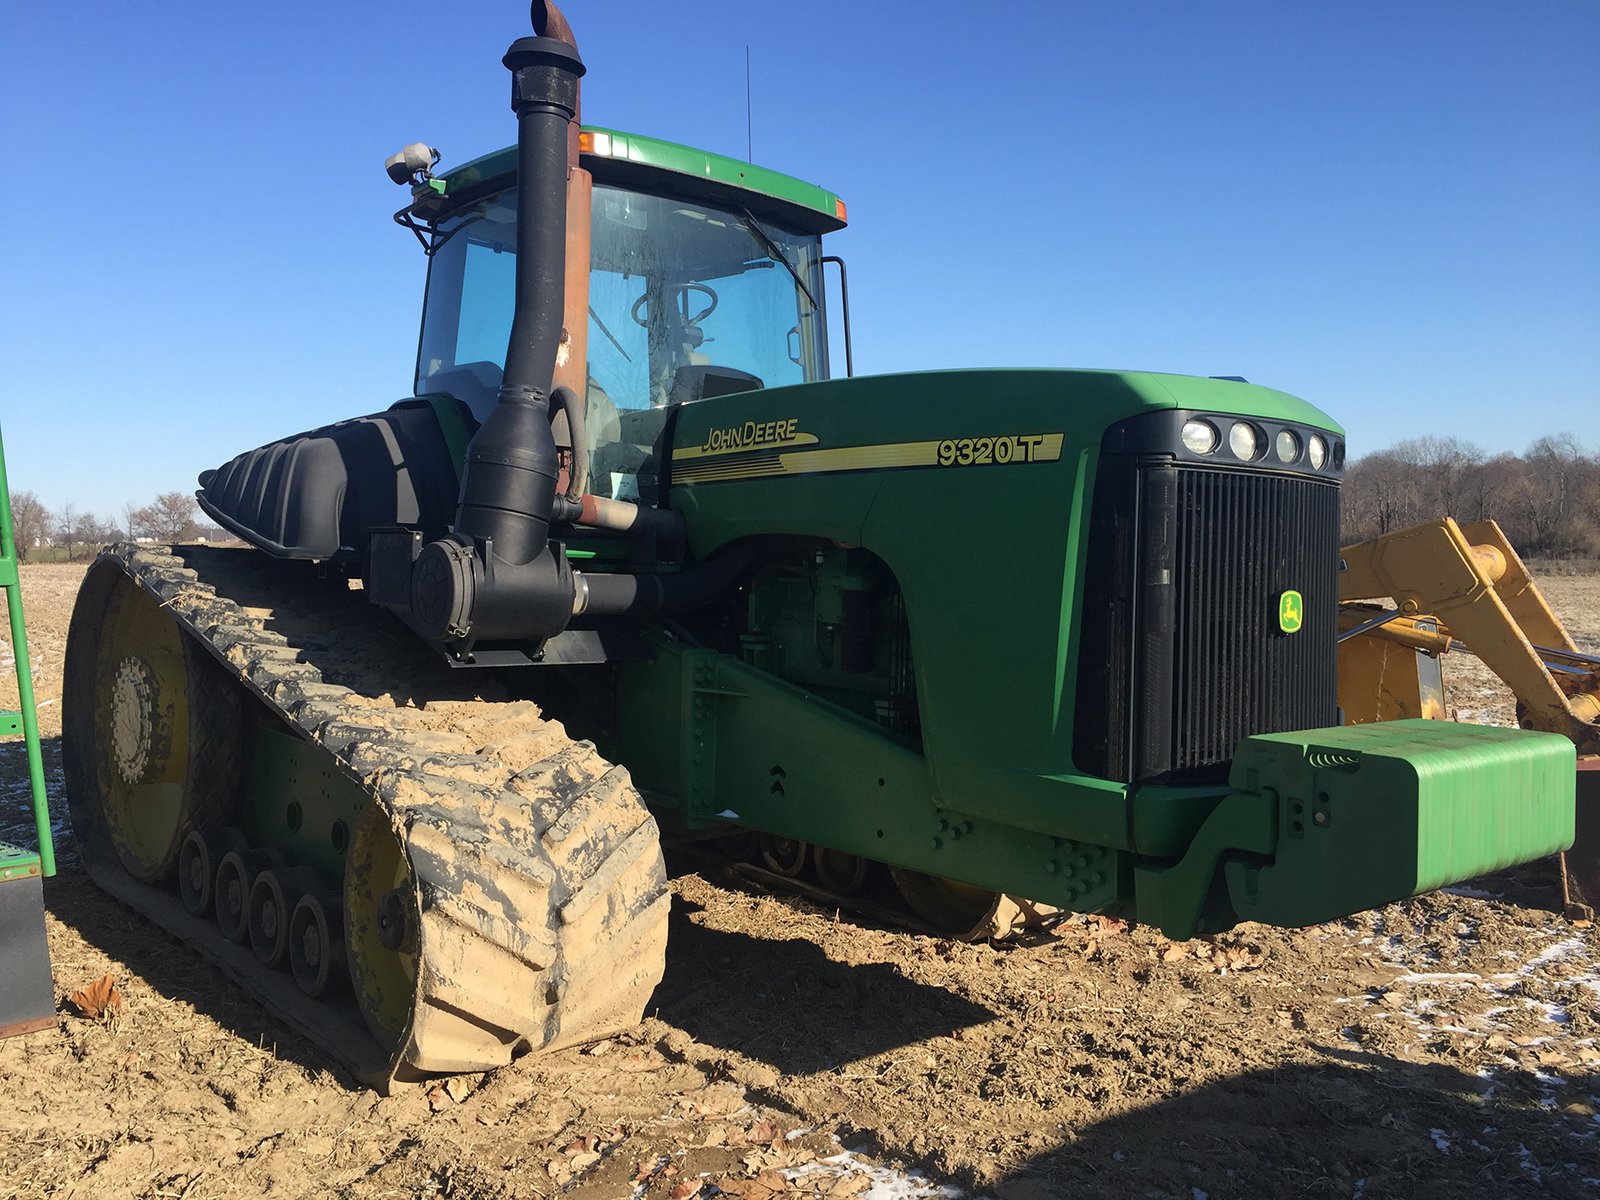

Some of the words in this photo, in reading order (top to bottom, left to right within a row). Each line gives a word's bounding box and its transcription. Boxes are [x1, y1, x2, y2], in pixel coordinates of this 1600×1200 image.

[703, 427, 743, 450] JOHN
[743, 418, 799, 445] DEERE
[938, 435, 1043, 466] 9320T
